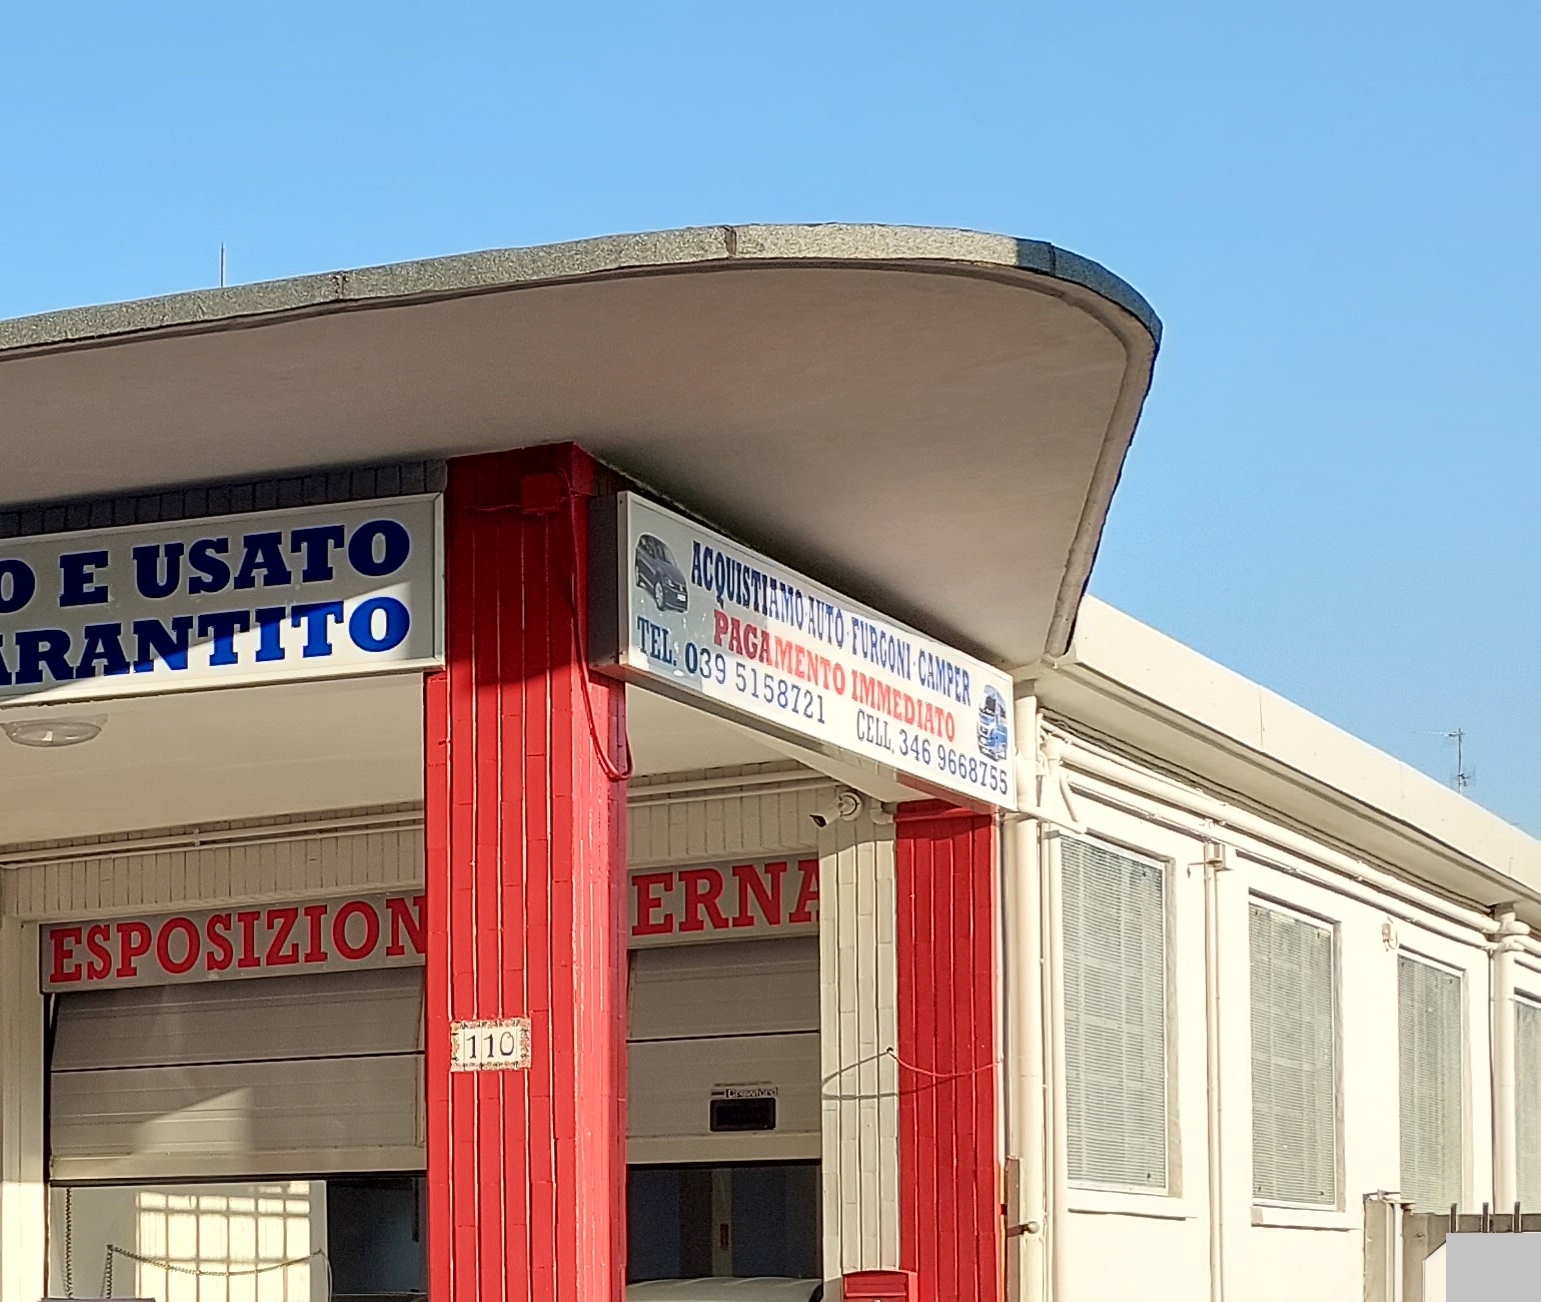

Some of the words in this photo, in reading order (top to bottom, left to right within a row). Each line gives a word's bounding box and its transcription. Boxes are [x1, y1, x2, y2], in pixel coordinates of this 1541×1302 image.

[59, 549, 110, 609] E
[132, 519, 411, 599] USATO
[636, 615, 678, 667] TEL.
[684, 641, 727, 685] 039
[735, 661, 825, 725] 5158721
[691, 540, 804, 631] ACQUISTIAMO
[851, 616, 911, 681] FURGONI
[918, 648, 972, 707] CAMPER
[713, 608, 846, 696] PAGAMENTO
[851, 669, 956, 743] IMMEDIATO
[899, 728, 932, 766] 346
[937, 744, 1009, 796] 9668755
[466, 1031, 515, 1059] 110
